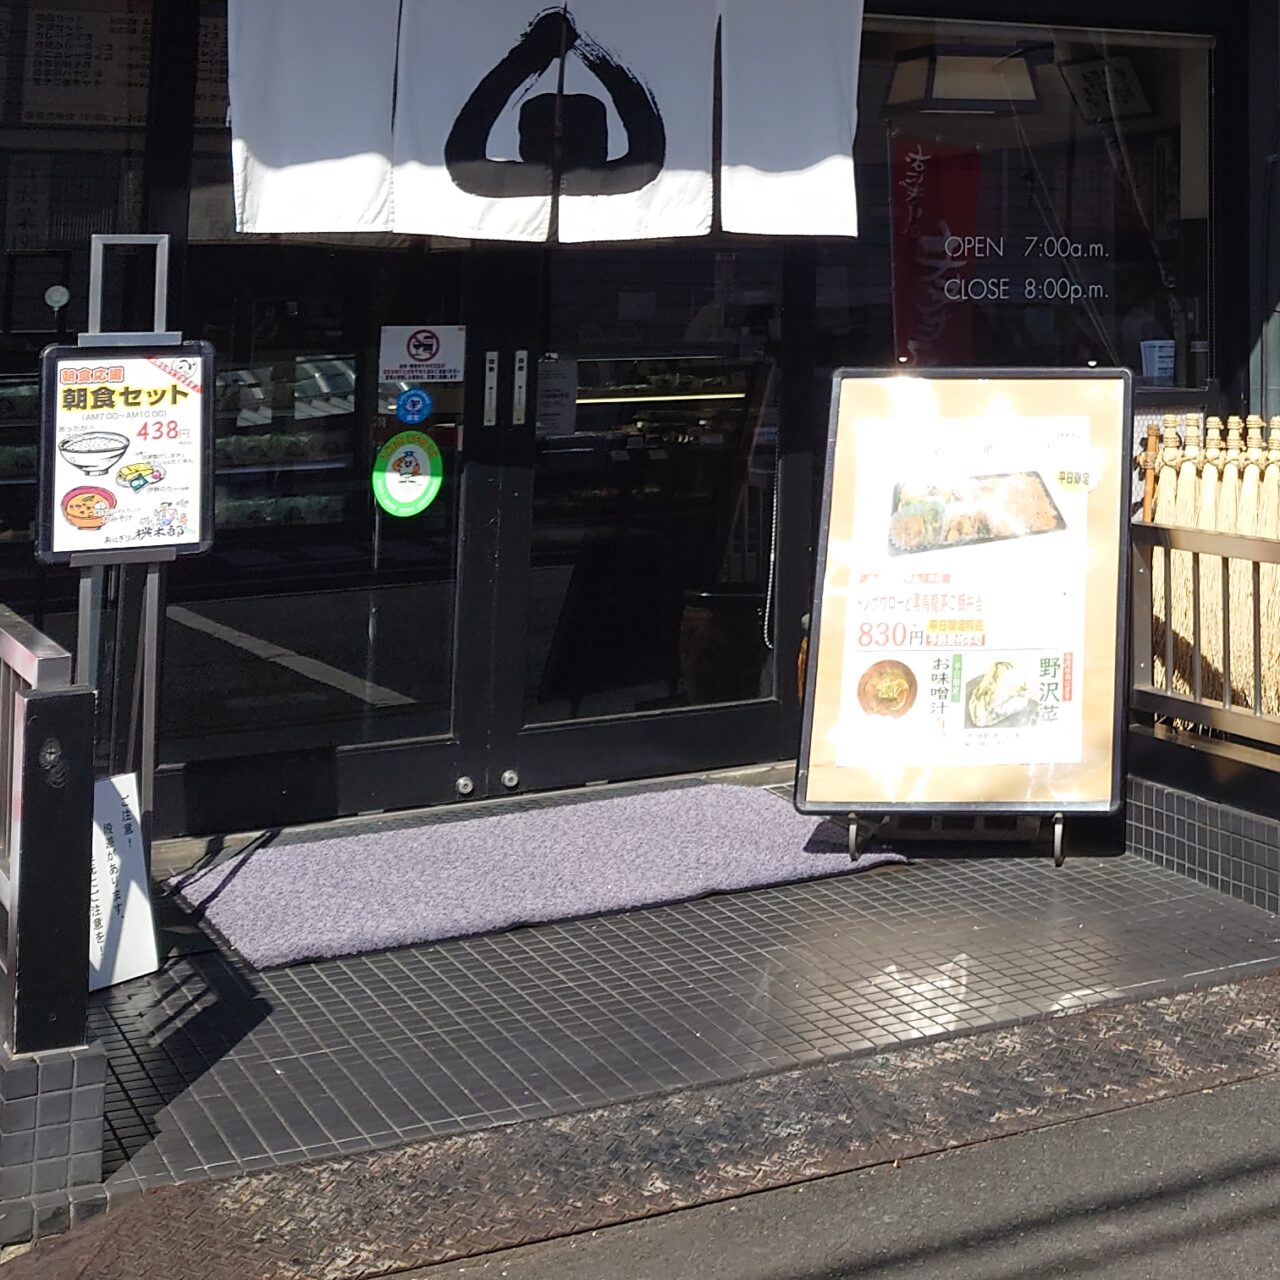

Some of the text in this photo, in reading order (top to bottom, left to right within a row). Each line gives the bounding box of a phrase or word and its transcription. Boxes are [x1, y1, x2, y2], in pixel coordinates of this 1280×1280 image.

[944, 236, 1110, 258] OPEN 7:00a.m.
[944, 278, 1110, 305] CLOSE 8:00p.m.
[62, 385, 190, 411] 朝食セット
[136, 420, 190, 441] 438円
[857, 622, 924, 647] 830円
[930, 657, 951, 716] お味噌汁
[1038, 657, 1061, 722] 野沢菜
